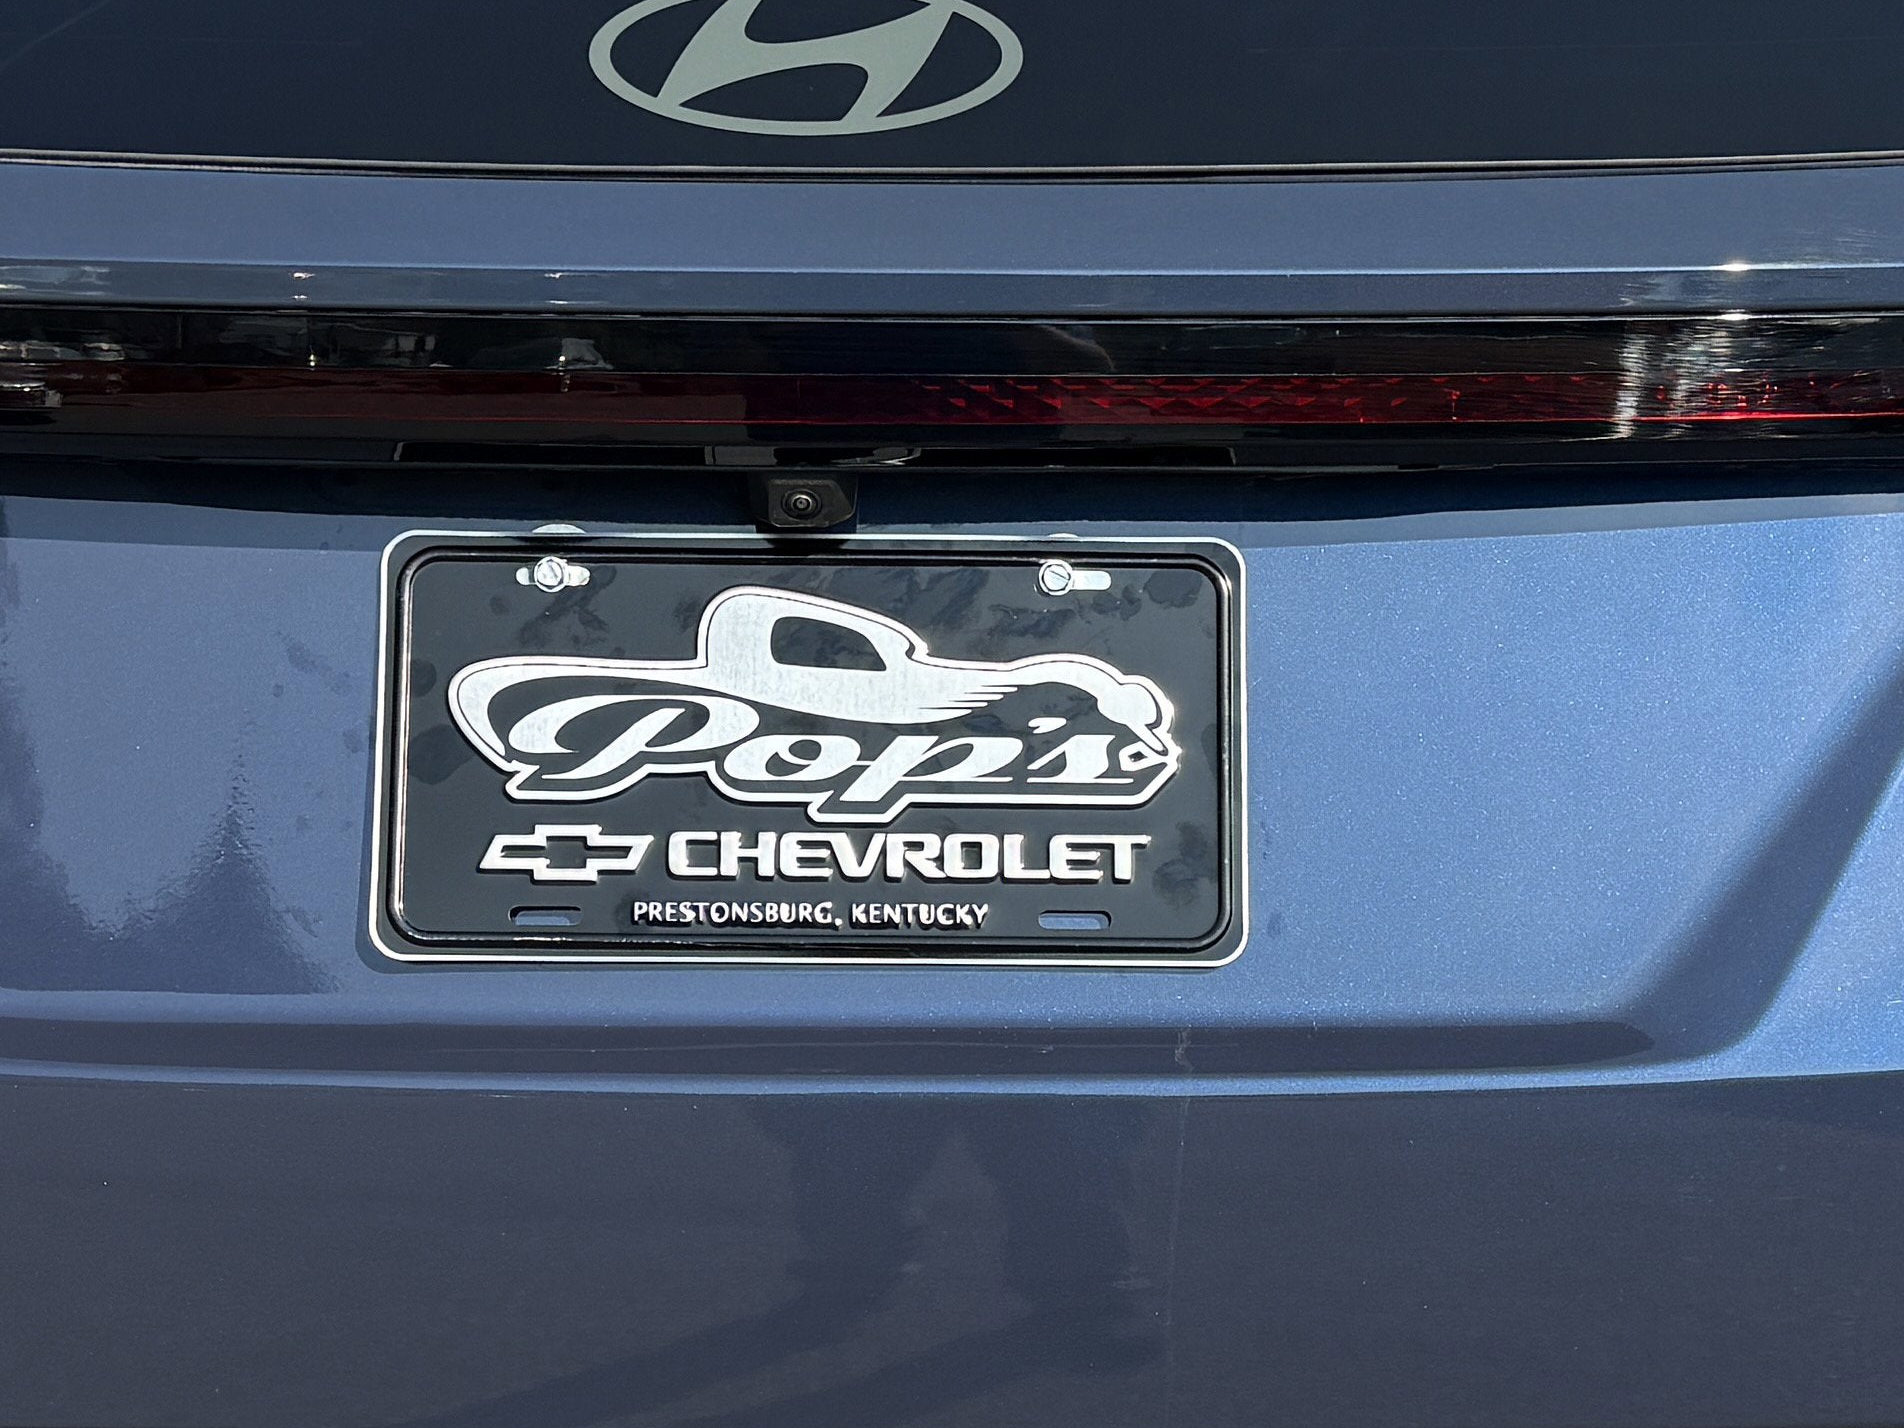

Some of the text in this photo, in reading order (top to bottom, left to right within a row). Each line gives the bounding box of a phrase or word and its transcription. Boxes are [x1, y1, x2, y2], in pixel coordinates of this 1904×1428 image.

[508, 694, 1134, 803] Pop's
[667, 831, 1152, 883] CHEVROLET
[633, 901, 990, 927] PRESTONSBURG, KENTUCKY
